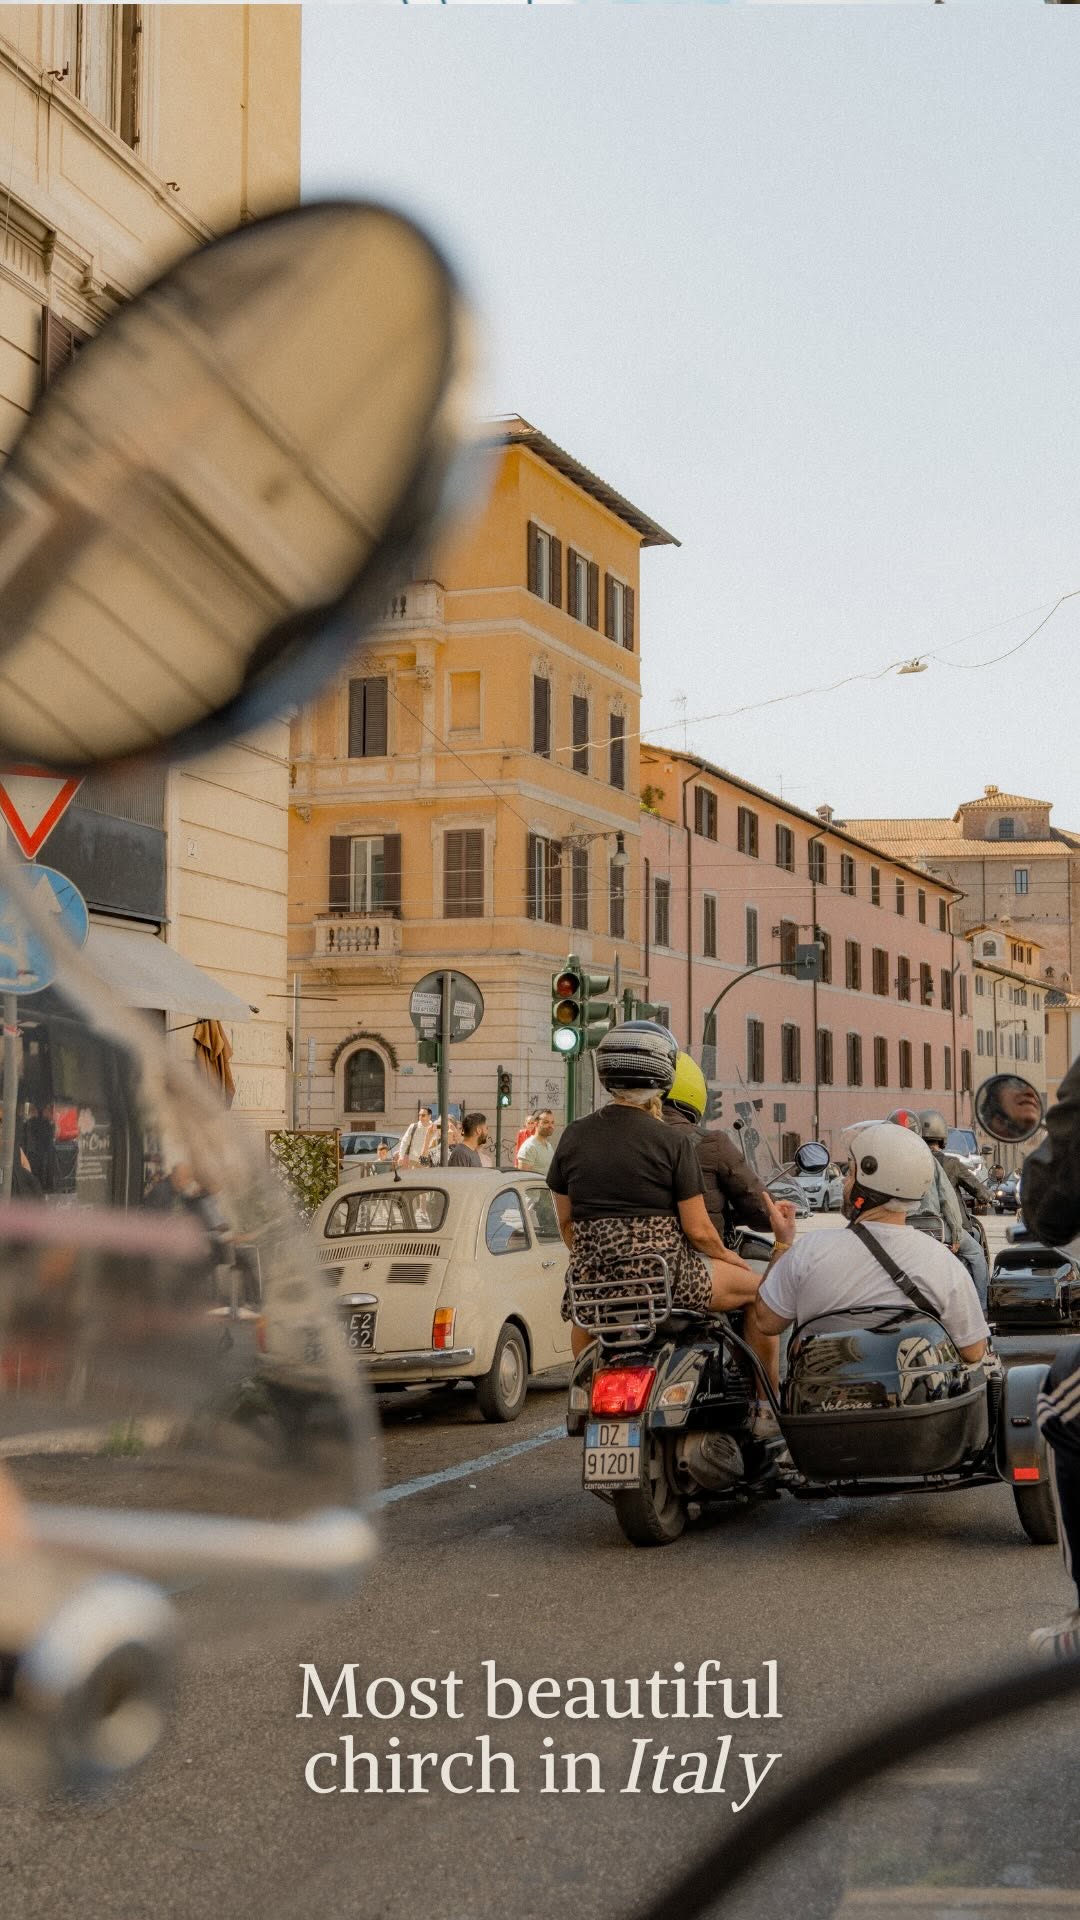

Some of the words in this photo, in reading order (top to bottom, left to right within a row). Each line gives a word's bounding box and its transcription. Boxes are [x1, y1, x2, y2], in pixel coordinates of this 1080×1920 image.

[350, 1313, 372, 1330] E2
[342, 1330, 371, 1348] 62
[821, 1400, 873, 1412] Velorex
[599, 1424, 619, 1446] DZ
[587, 1452, 635, 1475] 91201
